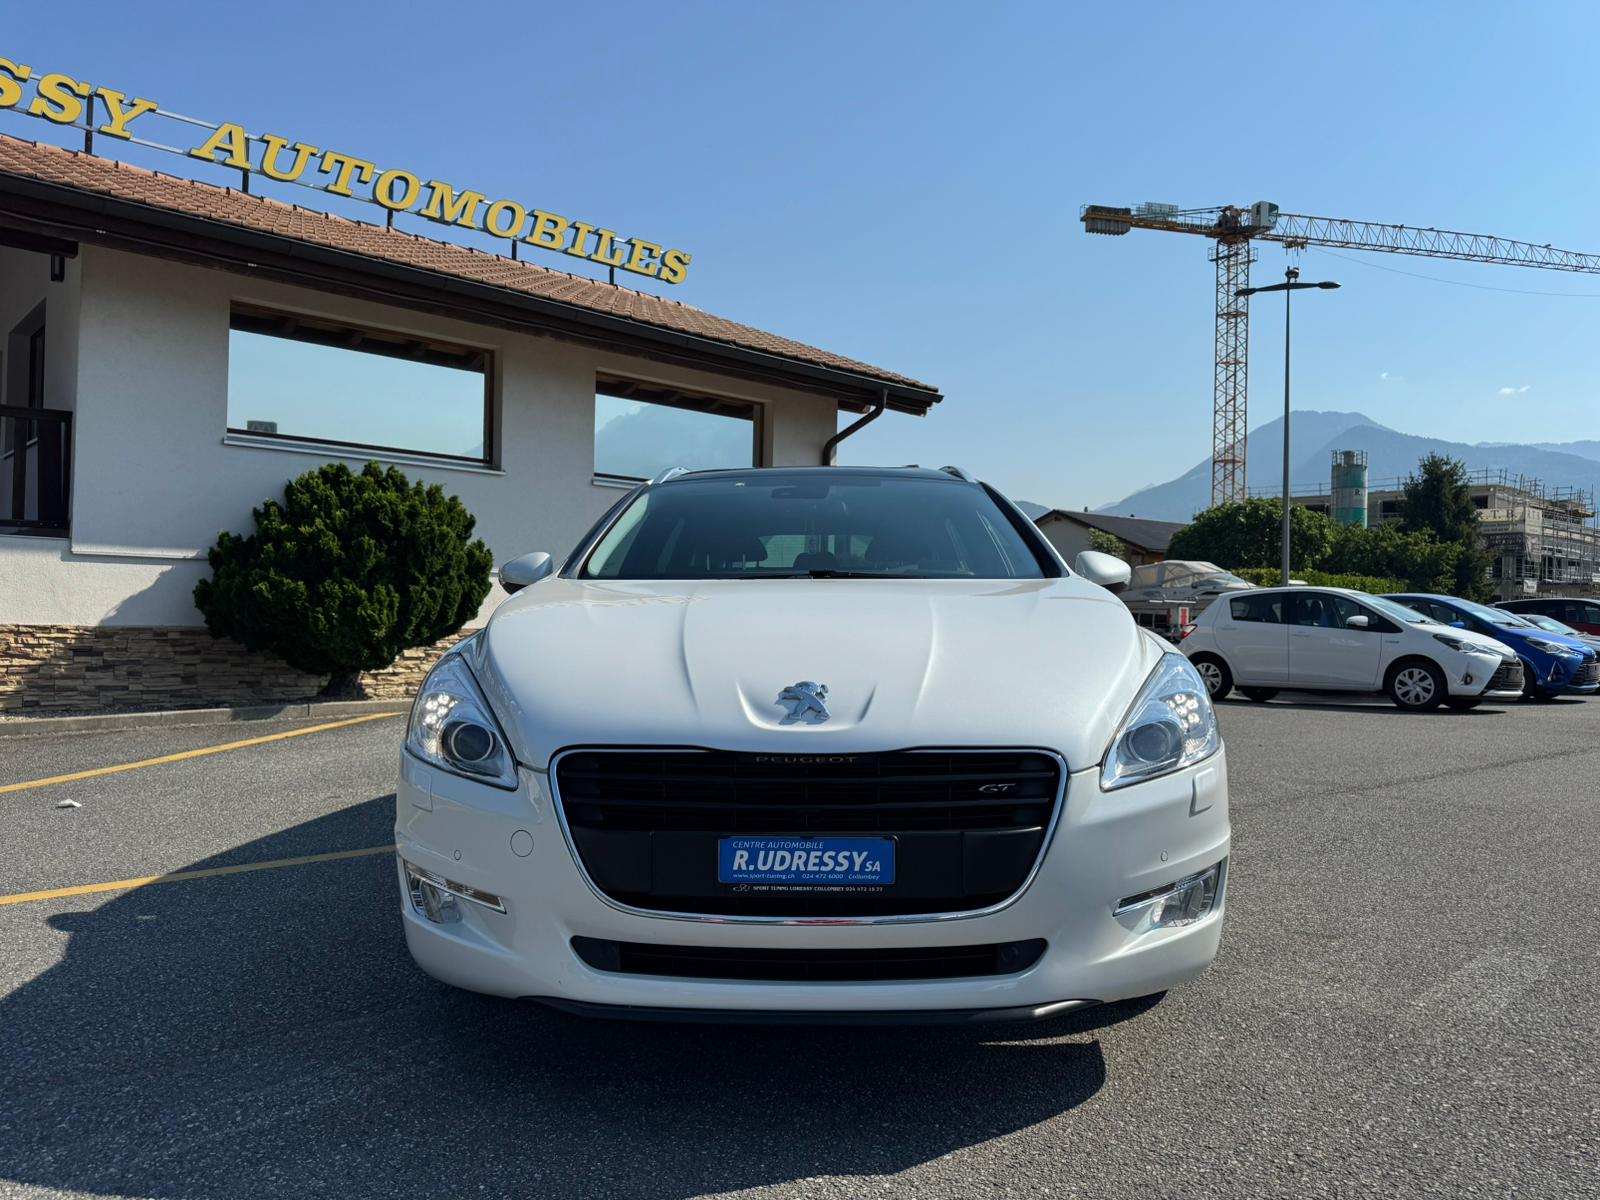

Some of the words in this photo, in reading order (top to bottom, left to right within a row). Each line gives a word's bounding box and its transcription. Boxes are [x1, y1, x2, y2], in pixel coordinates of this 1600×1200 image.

[188, 121, 691, 285] AUTOMOBILES
[978, 783, 1016, 793] GT
[733, 841, 766, 849] CENTRE
[767, 841, 825, 849] AUTOMOBILE
[733, 850, 868, 872] R.UDRESSY
[864, 861, 881, 872] SA
